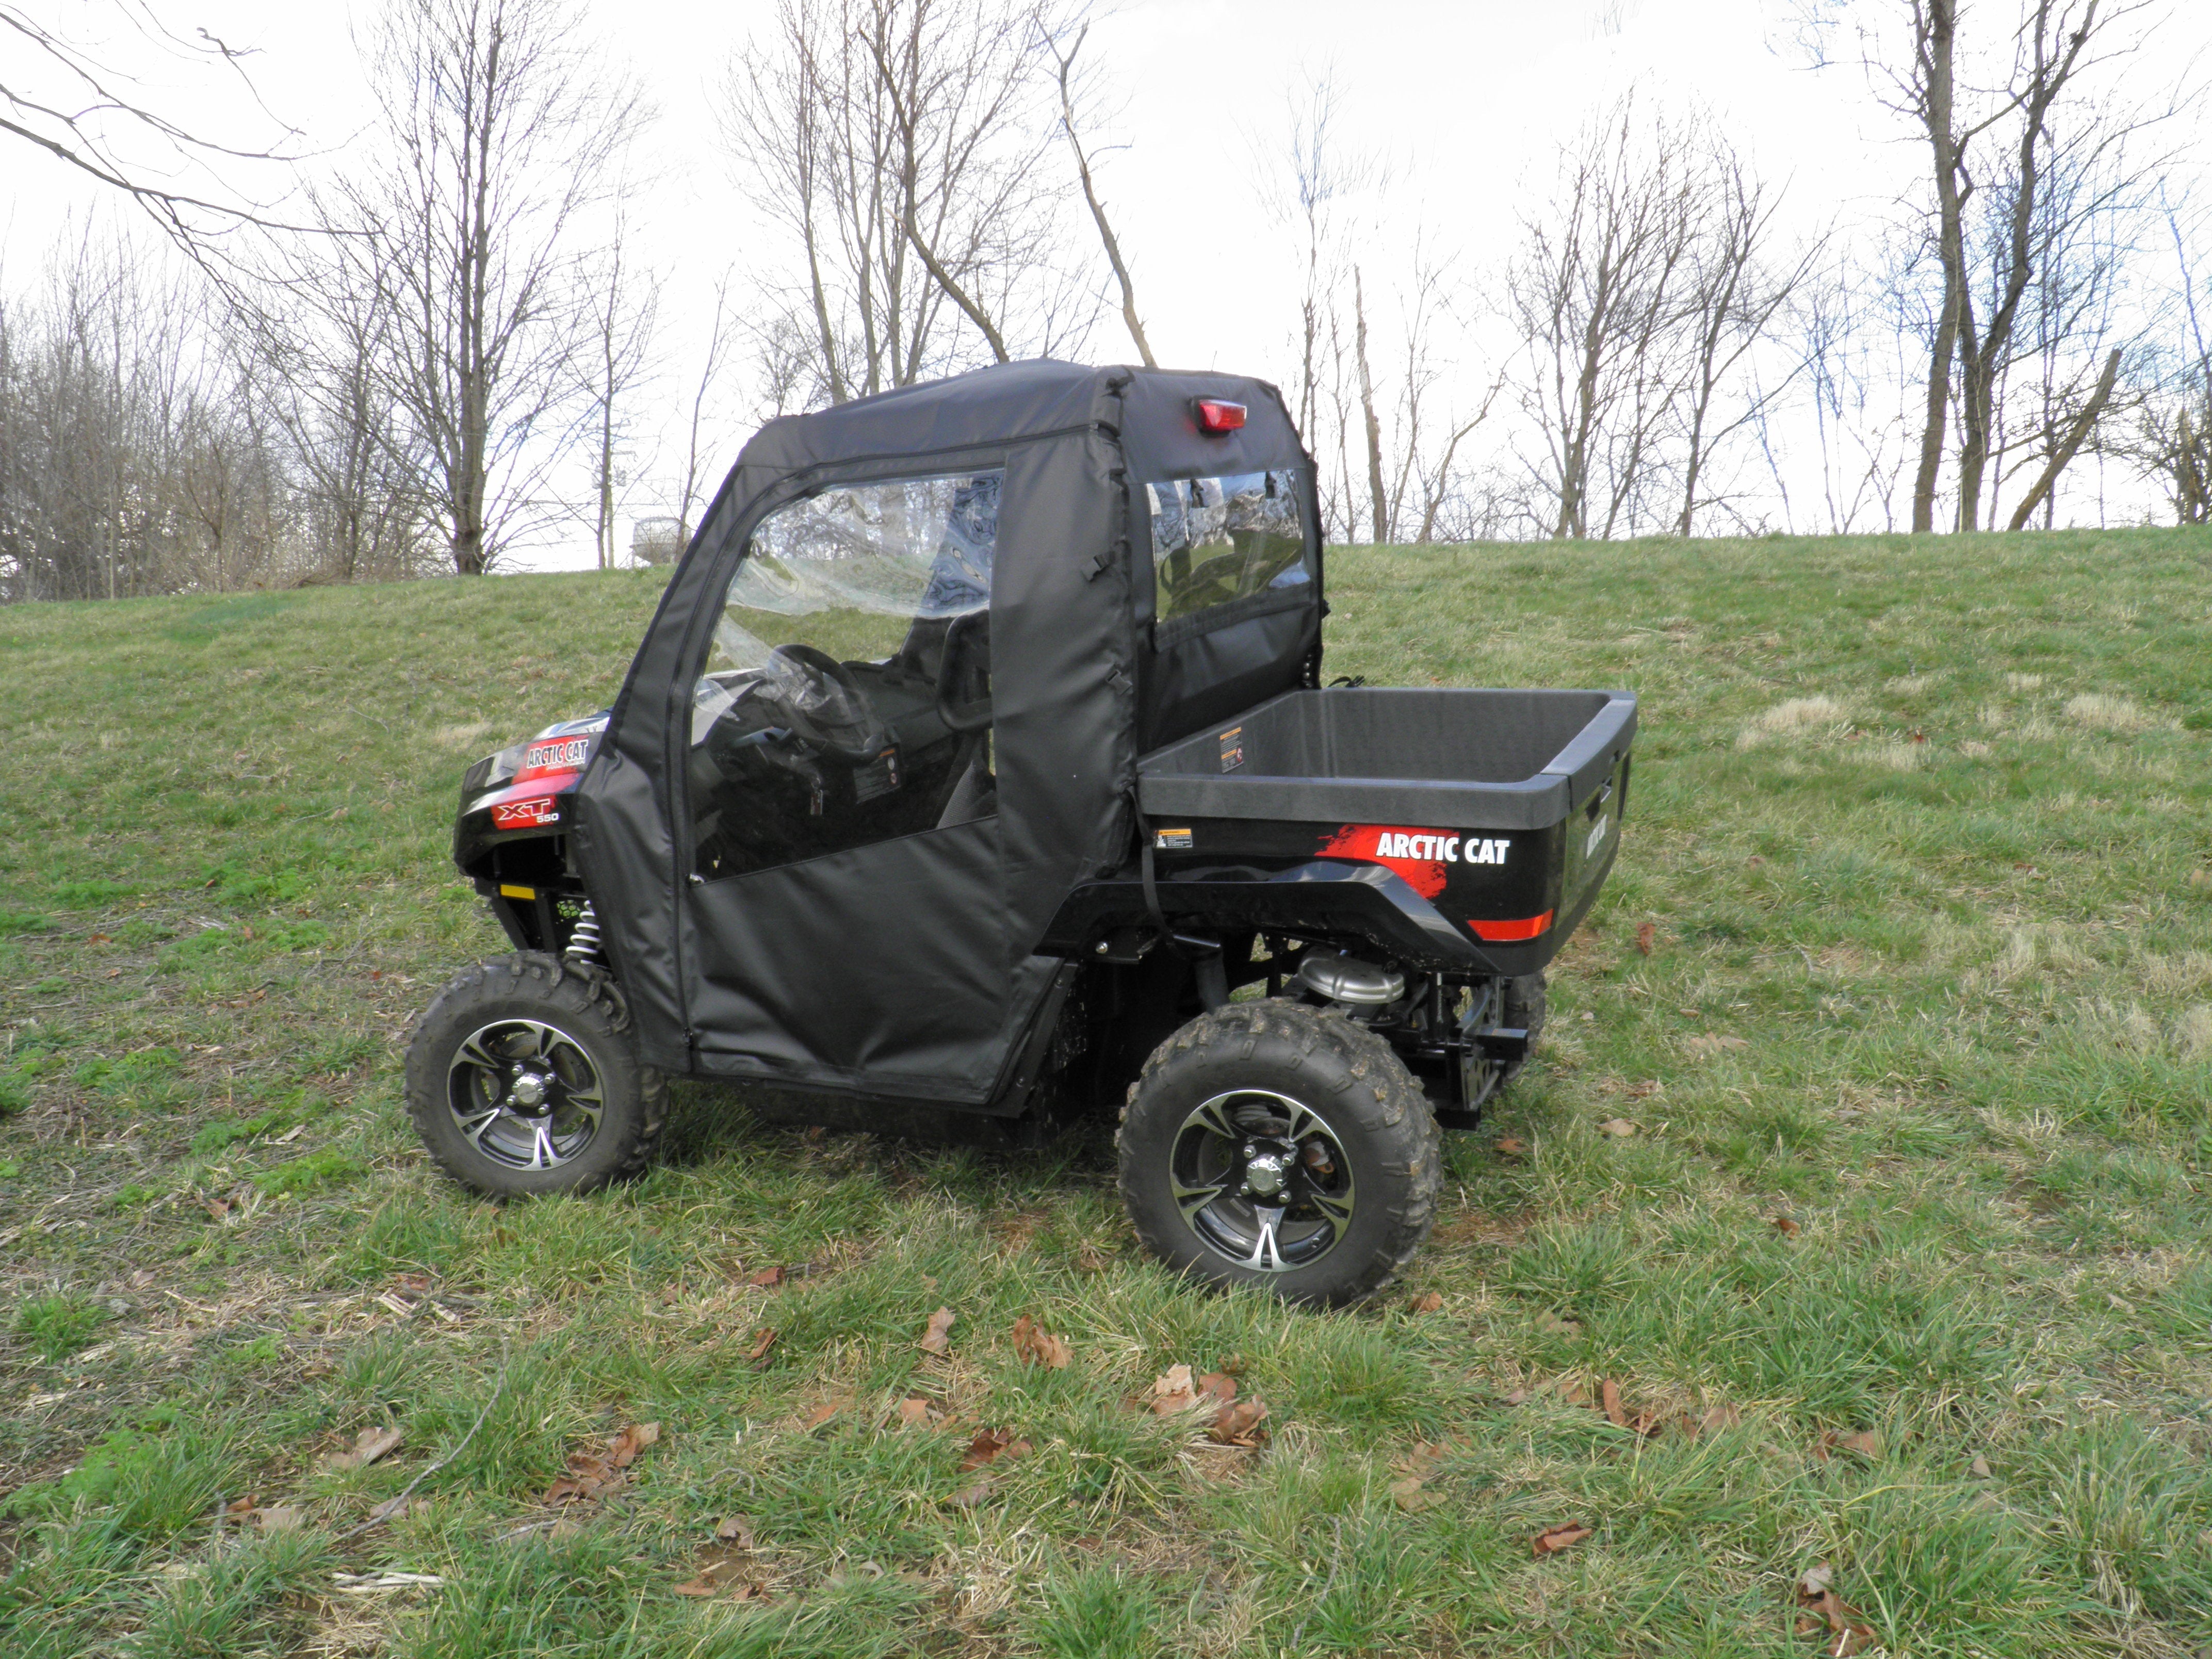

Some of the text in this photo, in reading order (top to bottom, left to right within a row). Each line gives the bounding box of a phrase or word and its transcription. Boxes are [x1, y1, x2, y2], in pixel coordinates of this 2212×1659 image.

[527, 743, 563, 769] ARCTIC
[565, 739, 589, 761] CAT
[498, 798, 559, 823] XT 550
[1376, 832, 1510, 865] ARCTIC CAT
